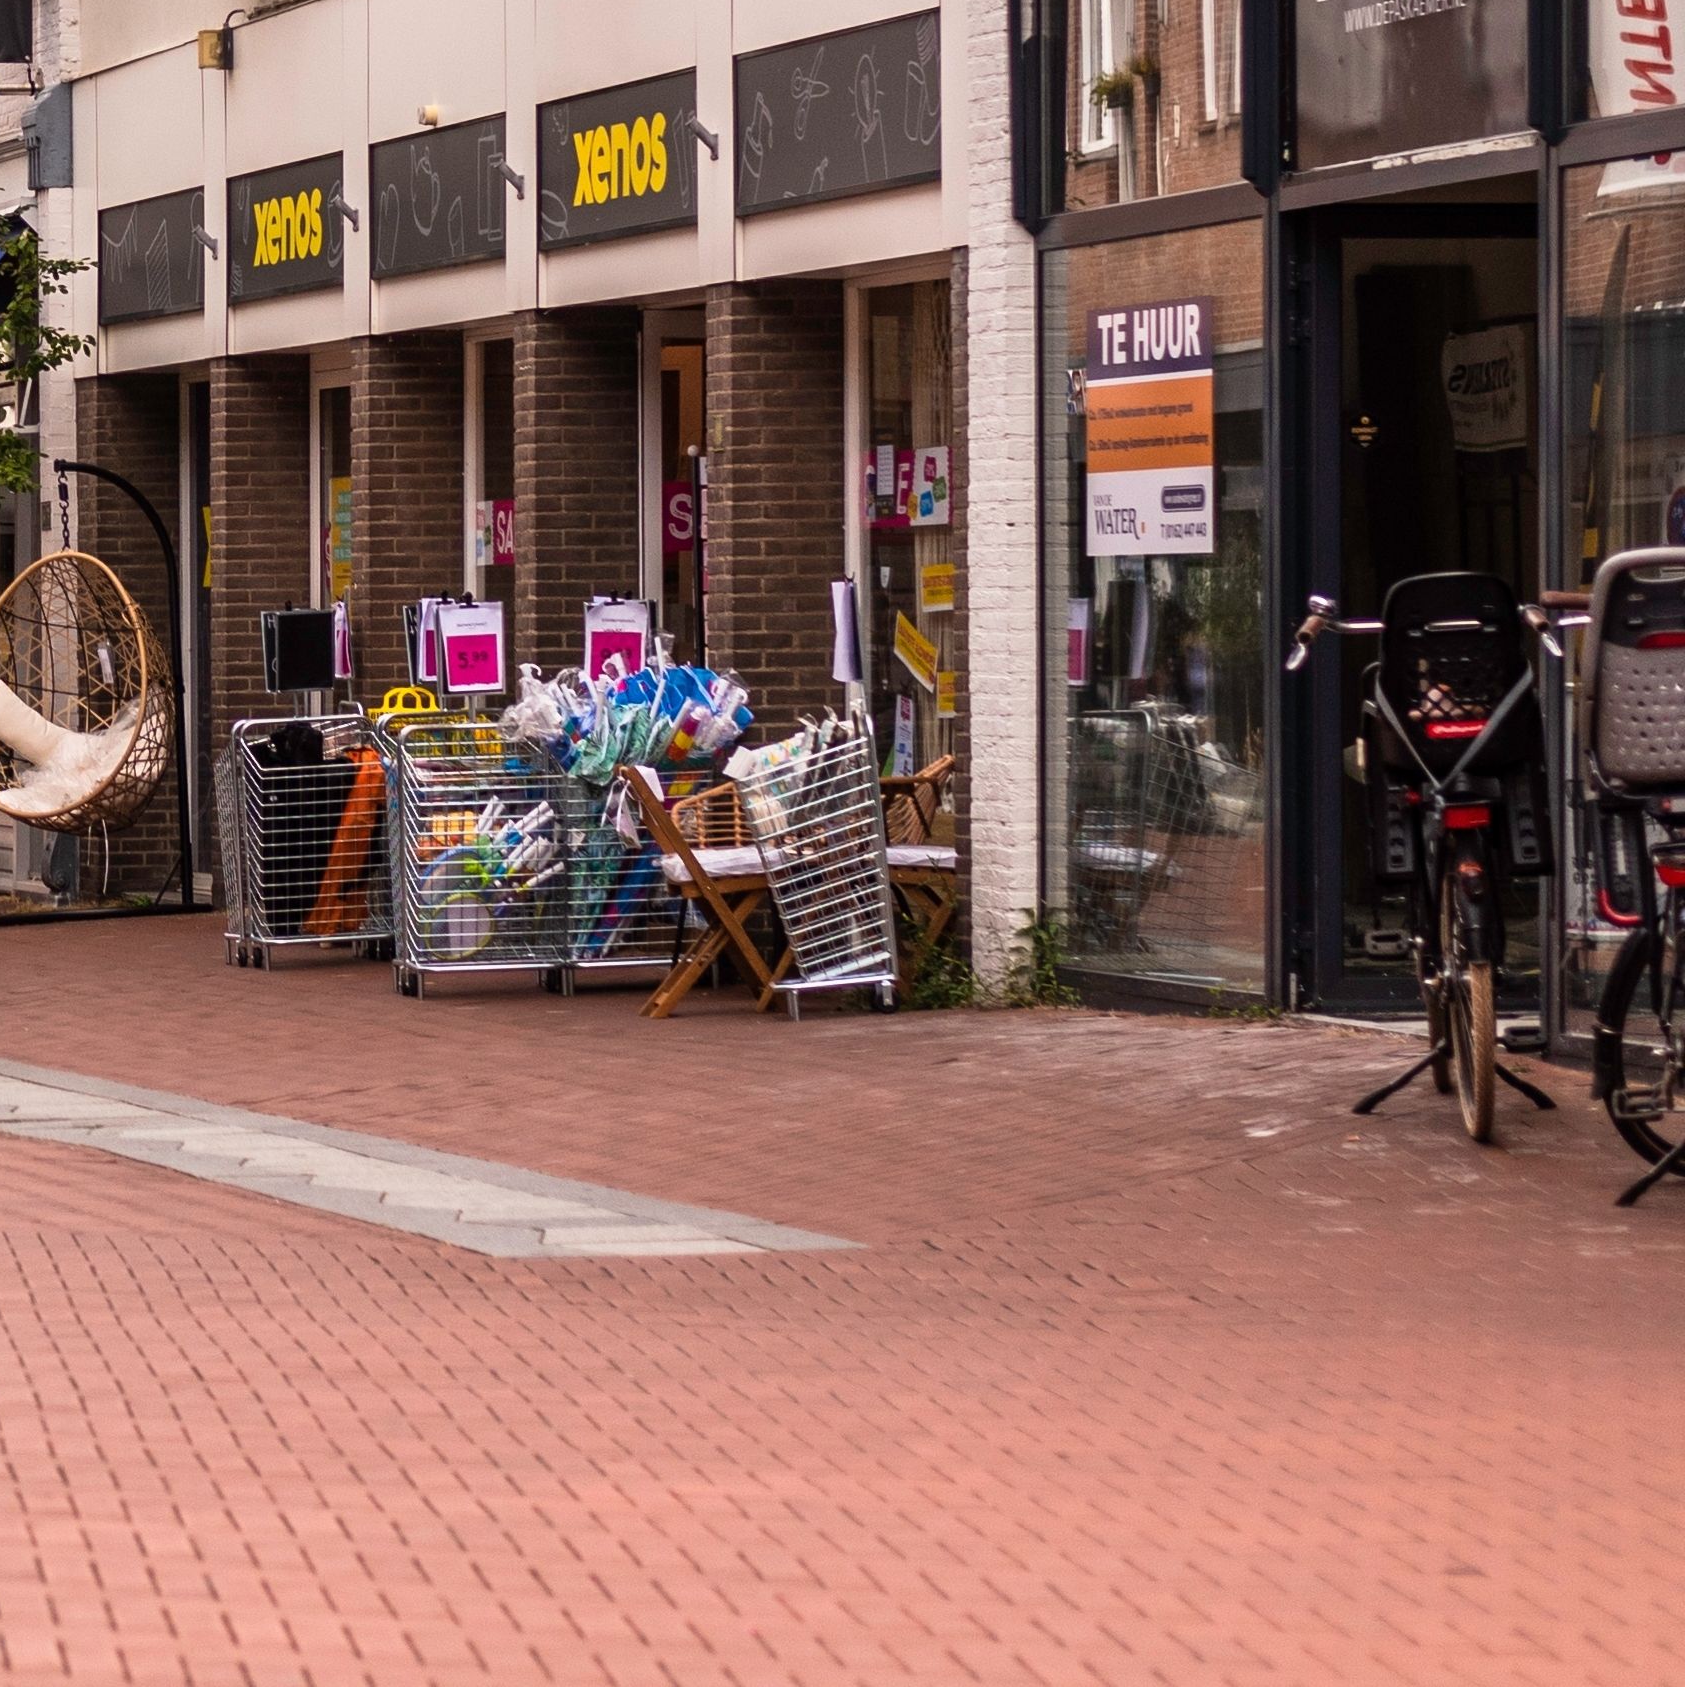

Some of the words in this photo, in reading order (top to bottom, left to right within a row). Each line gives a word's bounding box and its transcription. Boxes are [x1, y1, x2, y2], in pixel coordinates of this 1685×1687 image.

[573, 111, 667, 207] xenos
[253, 188, 323, 267] xenos
[1098, 313, 1126, 365] TE
[1133, 304, 1201, 362] HUUR
[1094, 508, 1140, 540] WATER
